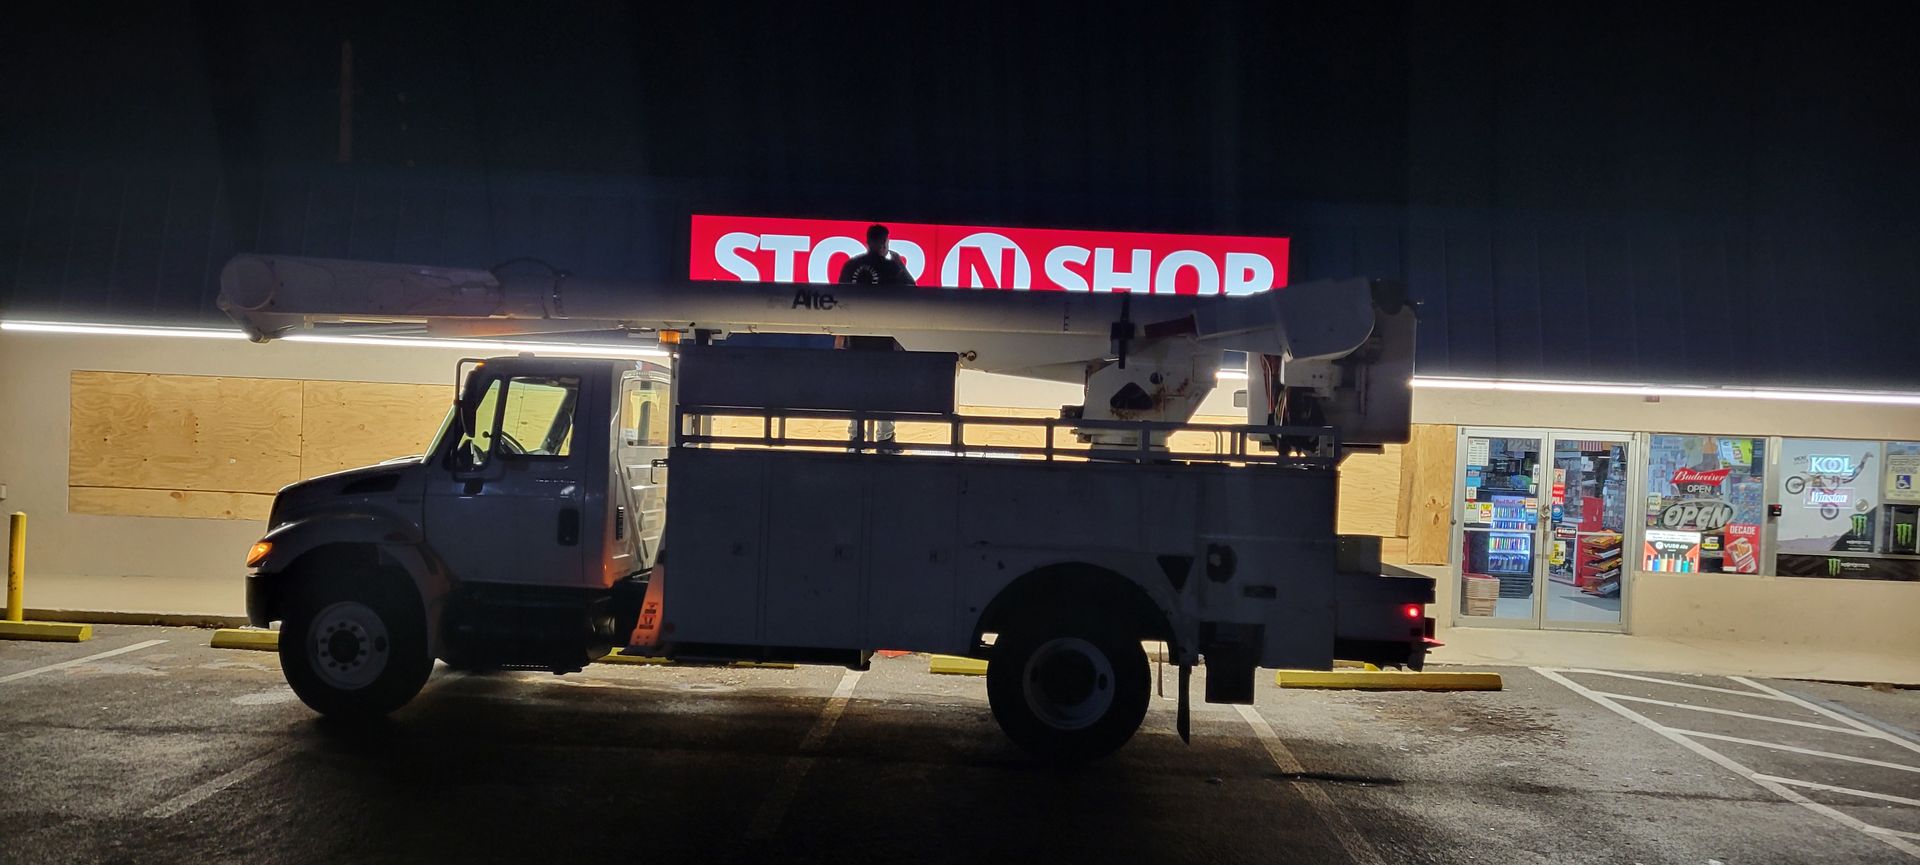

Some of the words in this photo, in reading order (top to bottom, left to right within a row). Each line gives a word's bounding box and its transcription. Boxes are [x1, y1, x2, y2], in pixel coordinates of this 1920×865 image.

[959, 245, 1017, 288] N
[1044, 245, 1274, 296] SHOP
[792, 287, 842, 310] Alte
[1810, 456, 1856, 473] KOOL
[1674, 470, 1726, 482] Budweiser
[1687, 484, 1712, 493] OPEN
[1810, 491, 1848, 503] Winston
[1663, 502, 1731, 530] OPEN
[1729, 525, 1756, 536] DECADE
